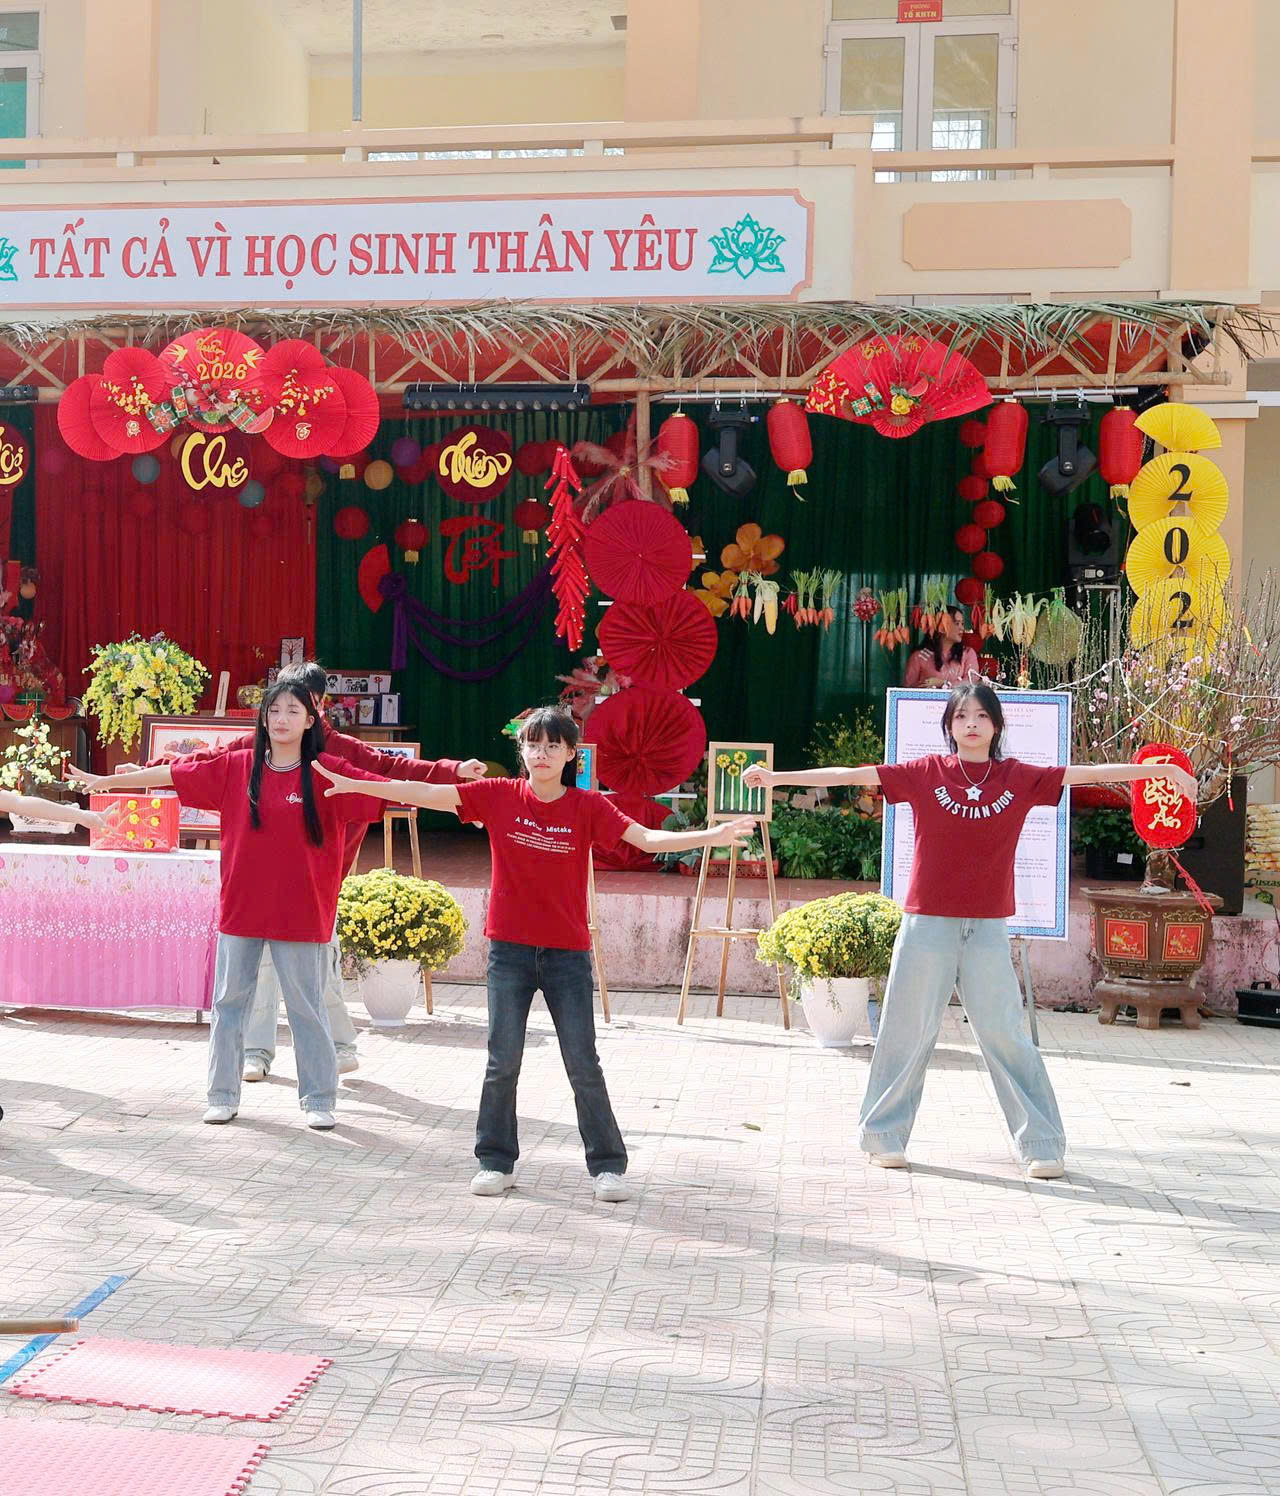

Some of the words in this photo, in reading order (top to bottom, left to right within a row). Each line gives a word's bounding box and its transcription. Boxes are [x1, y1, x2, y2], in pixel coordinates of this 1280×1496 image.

[30, 217, 111, 279] TẤT
[122, 217, 177, 278] CẢ
[186, 221, 232, 278] VÌ
[243, 233, 337, 291] HỌC
[348, 232, 457, 276] SINH
[468, 213, 594, 273] THÂN
[604, 213, 699, 272] YÊU
[197, 361, 248, 380] 2026
[933, 785, 991, 820] CHRISTIAN
[992, 788, 1016, 815] DIOR
[546, 826, 572, 834] Mistake
